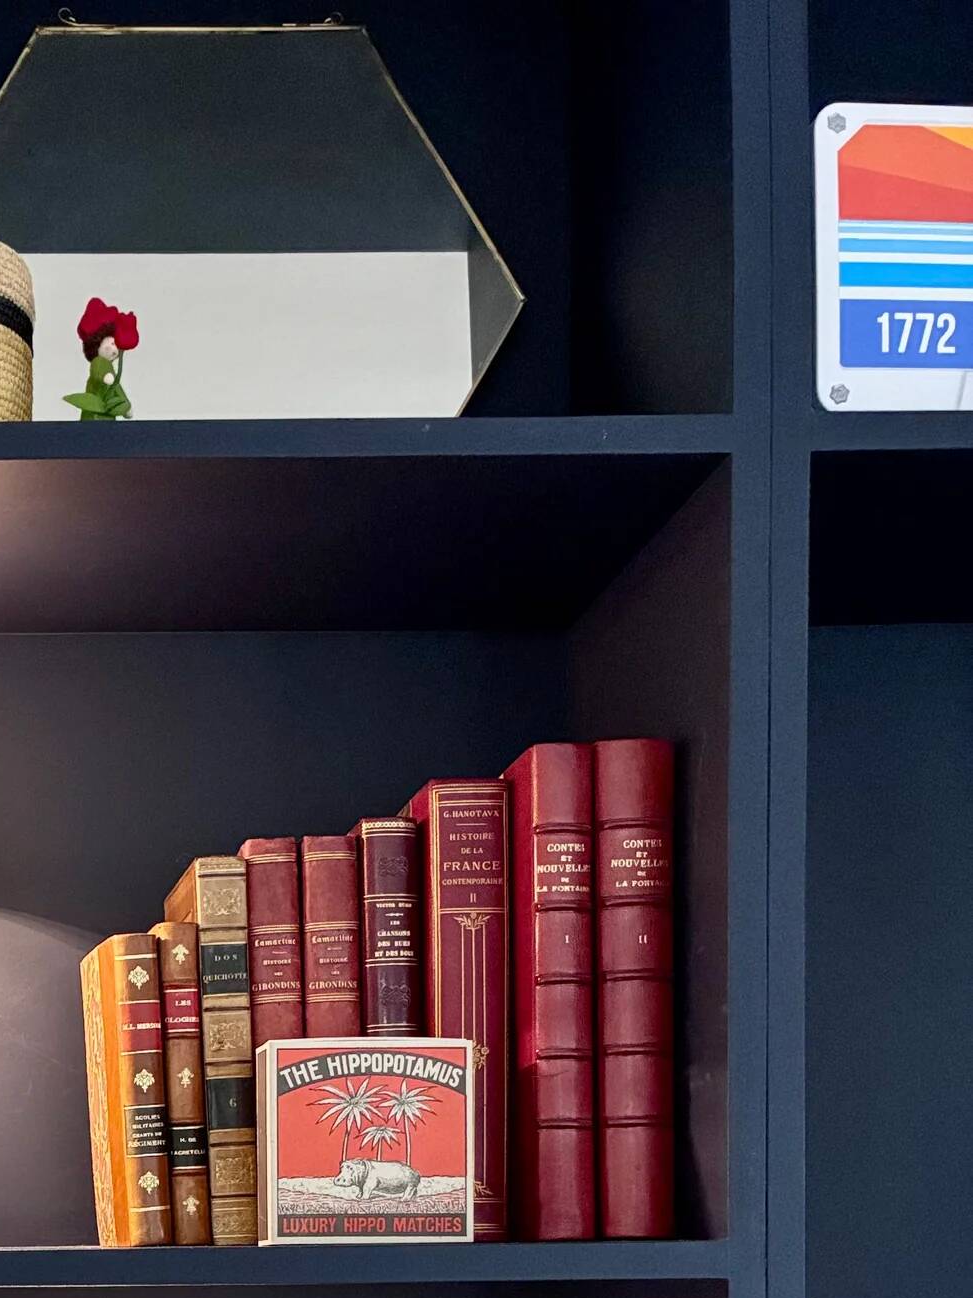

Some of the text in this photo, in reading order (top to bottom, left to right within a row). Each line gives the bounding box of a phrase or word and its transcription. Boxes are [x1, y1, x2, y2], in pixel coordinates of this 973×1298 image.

[876, 312, 956, 354] 1772
[449, 832, 496, 841] HISTOIRE
[460, 846, 484, 855] DE LA
[443, 860, 501, 872] FRANCE
[441, 878, 504, 887] CONTEMPORAINE
[615, 880, 628, 888] LA
[536, 885, 548, 893] LA
[469, 892, 478, 904] II
[251, 981, 302, 993] GIRONDINS
[308, 980, 358, 991] GIRONDINS
[280, 1053, 464, 1089] THE HIPPOPOTAMUS
[229, 1097, 238, 1108] 6
[282, 1216, 463, 1234] LUXURY HIPPO MATCHES
